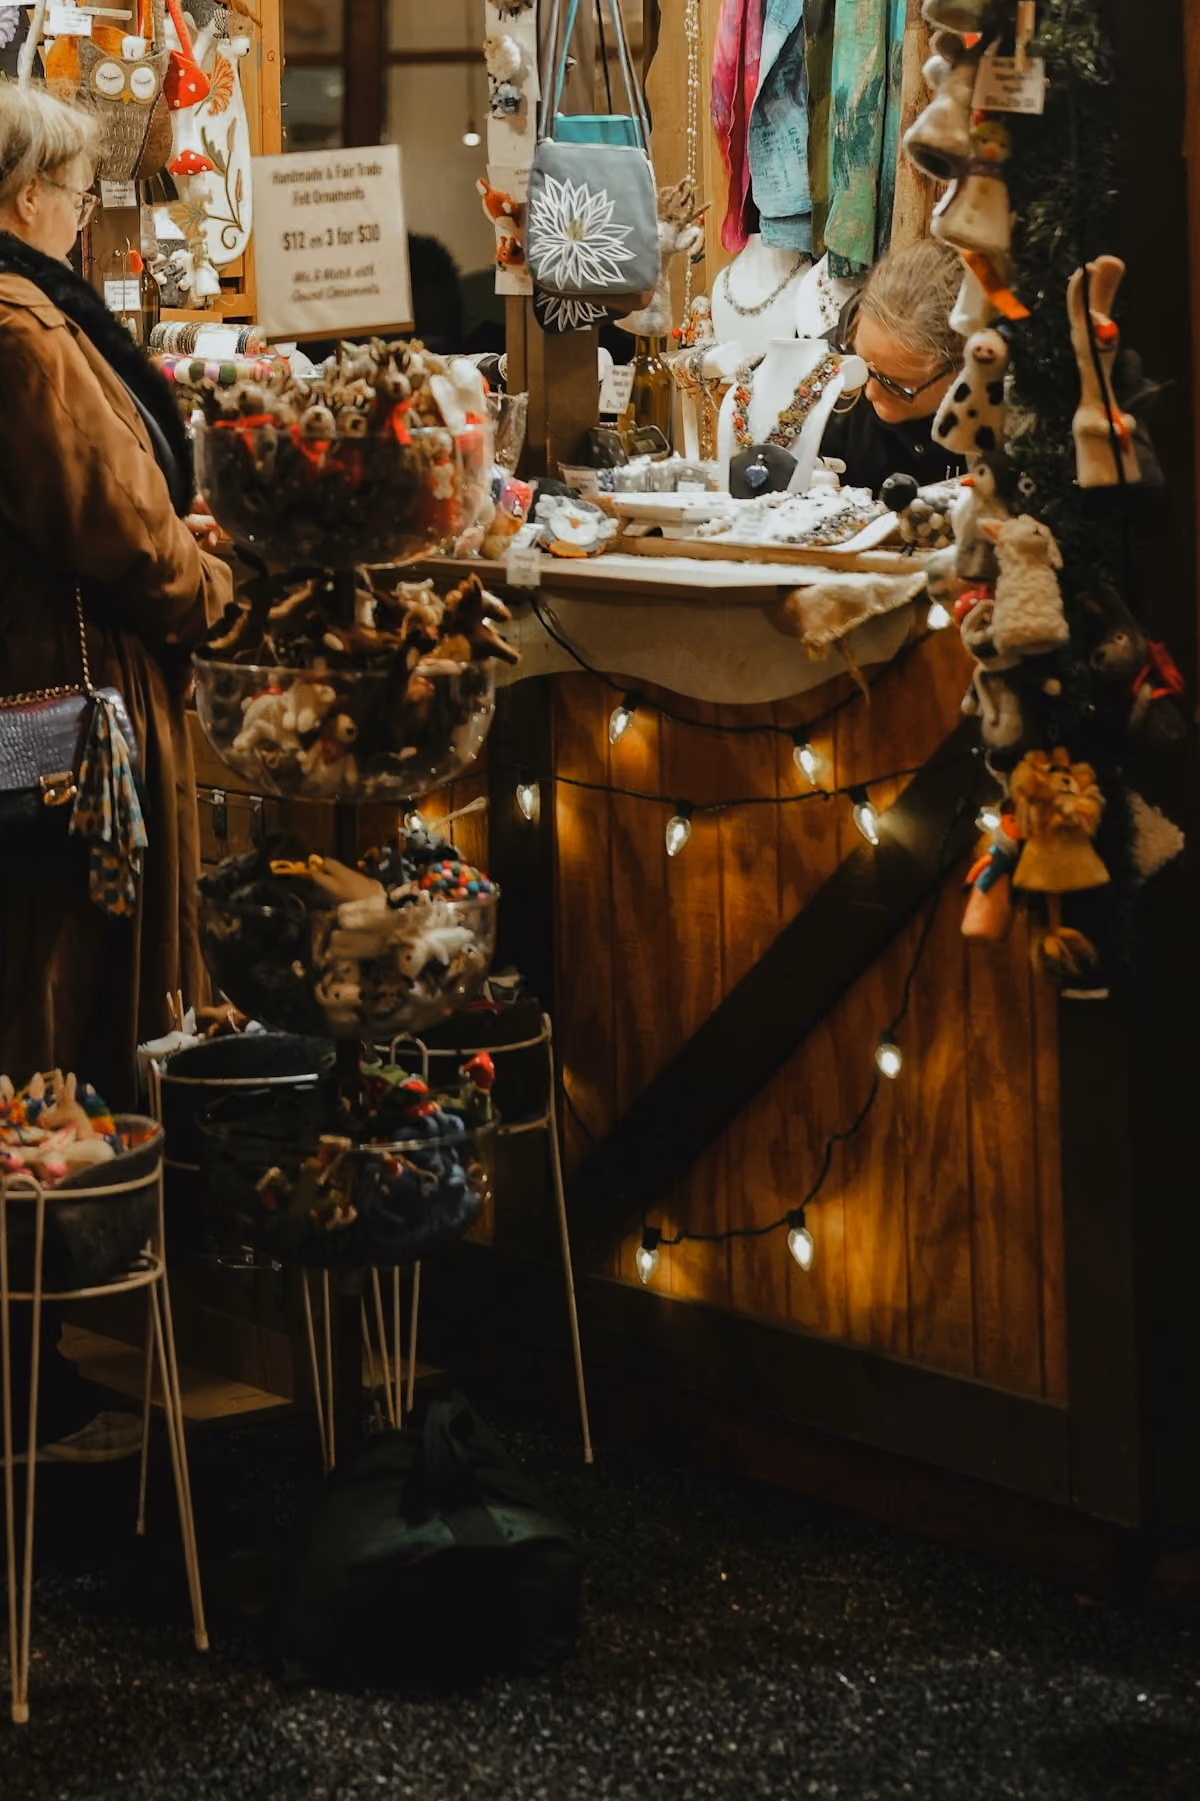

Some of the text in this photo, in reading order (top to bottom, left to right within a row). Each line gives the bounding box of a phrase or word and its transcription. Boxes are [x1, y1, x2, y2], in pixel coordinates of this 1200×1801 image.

[272, 161, 383, 185] Handmade & Fair Trade
[292, 186, 366, 206] Felt Ornaments
[282, 230, 306, 252] $12
[326, 228, 334, 247] 3
[337, 227, 355, 245] for
[357, 223, 381, 244] $30
[324, 264, 352, 281] Match
[355, 262, 375, 278] with
[327, 283, 381, 300] Ornaments
